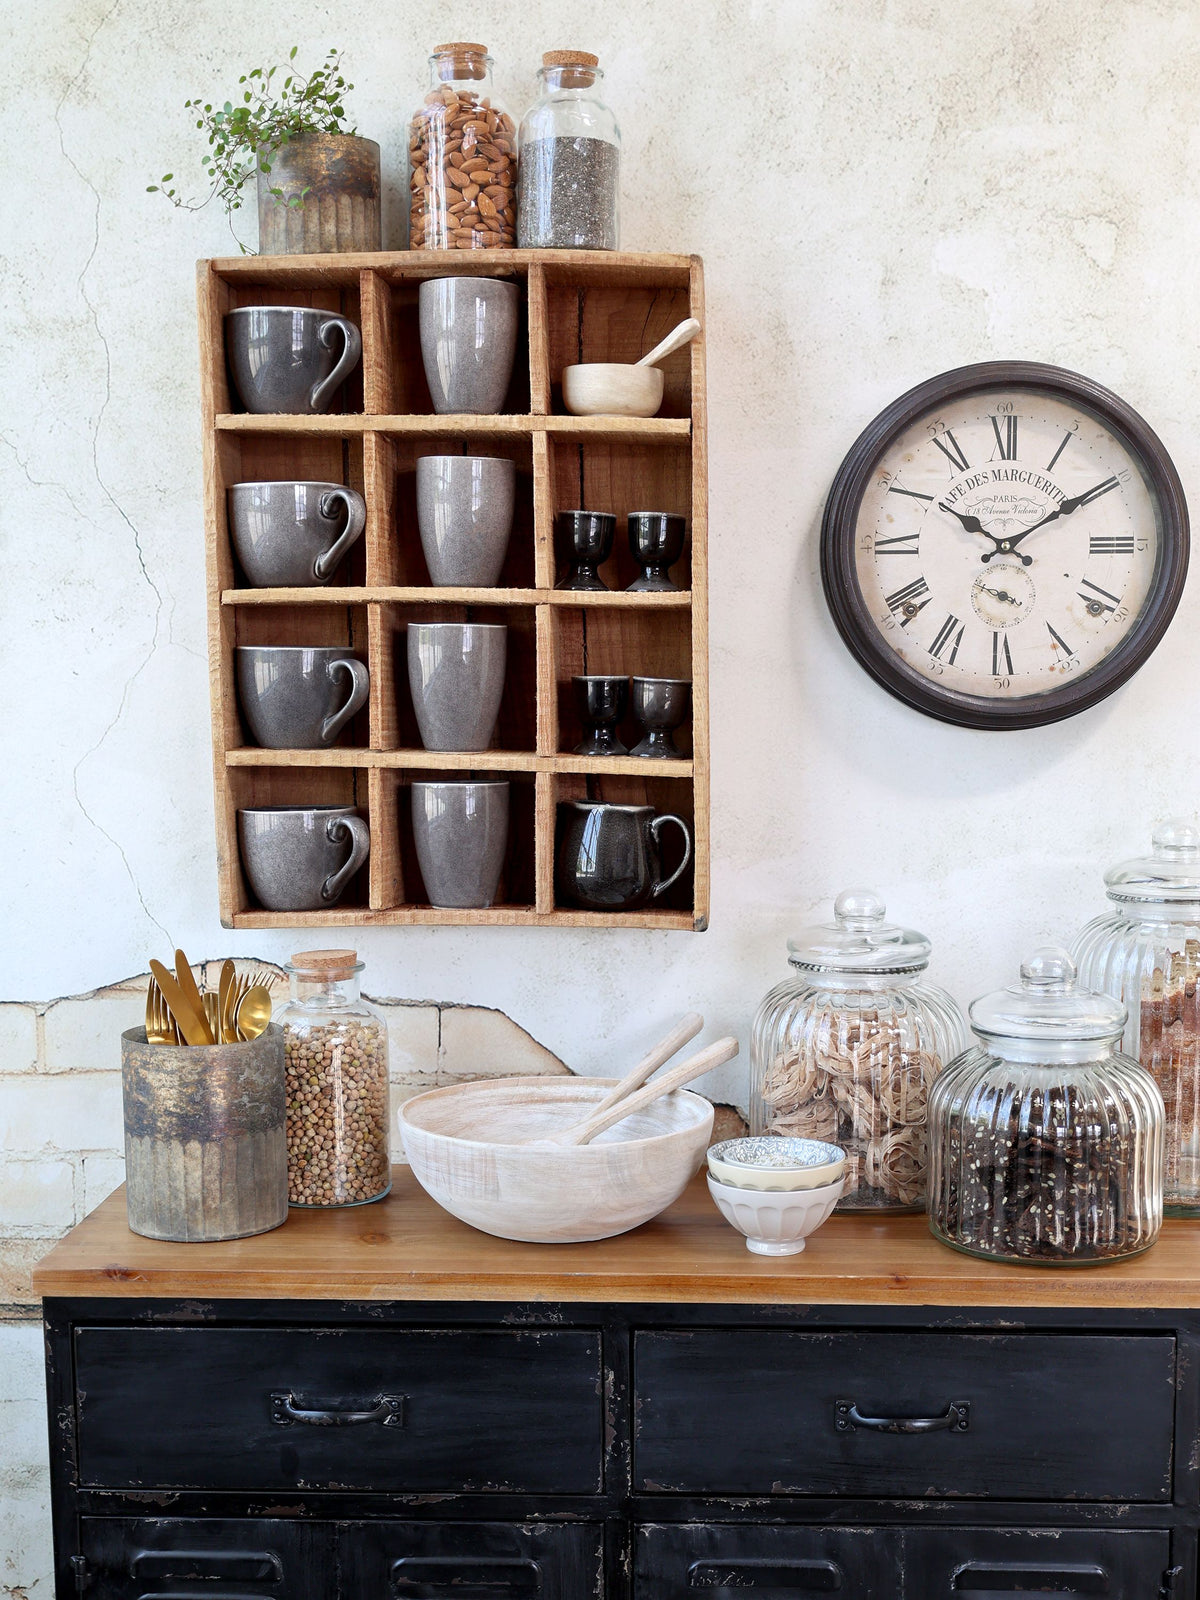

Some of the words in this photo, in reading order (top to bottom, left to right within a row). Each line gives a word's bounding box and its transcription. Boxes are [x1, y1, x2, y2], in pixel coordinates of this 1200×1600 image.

[997, 401, 1014, 414] 60
[926, 417, 945, 437] 55
[1071, 417, 1082, 432] 5
[985, 414, 1023, 463] XII
[923, 427, 975, 483] XI
[877, 471, 892, 489] 50
[965, 471, 989, 491] DES
[993, 495, 1018, 503] PARIS
[1088, 531, 1134, 559] III
[1136, 538, 1149, 552] 15
